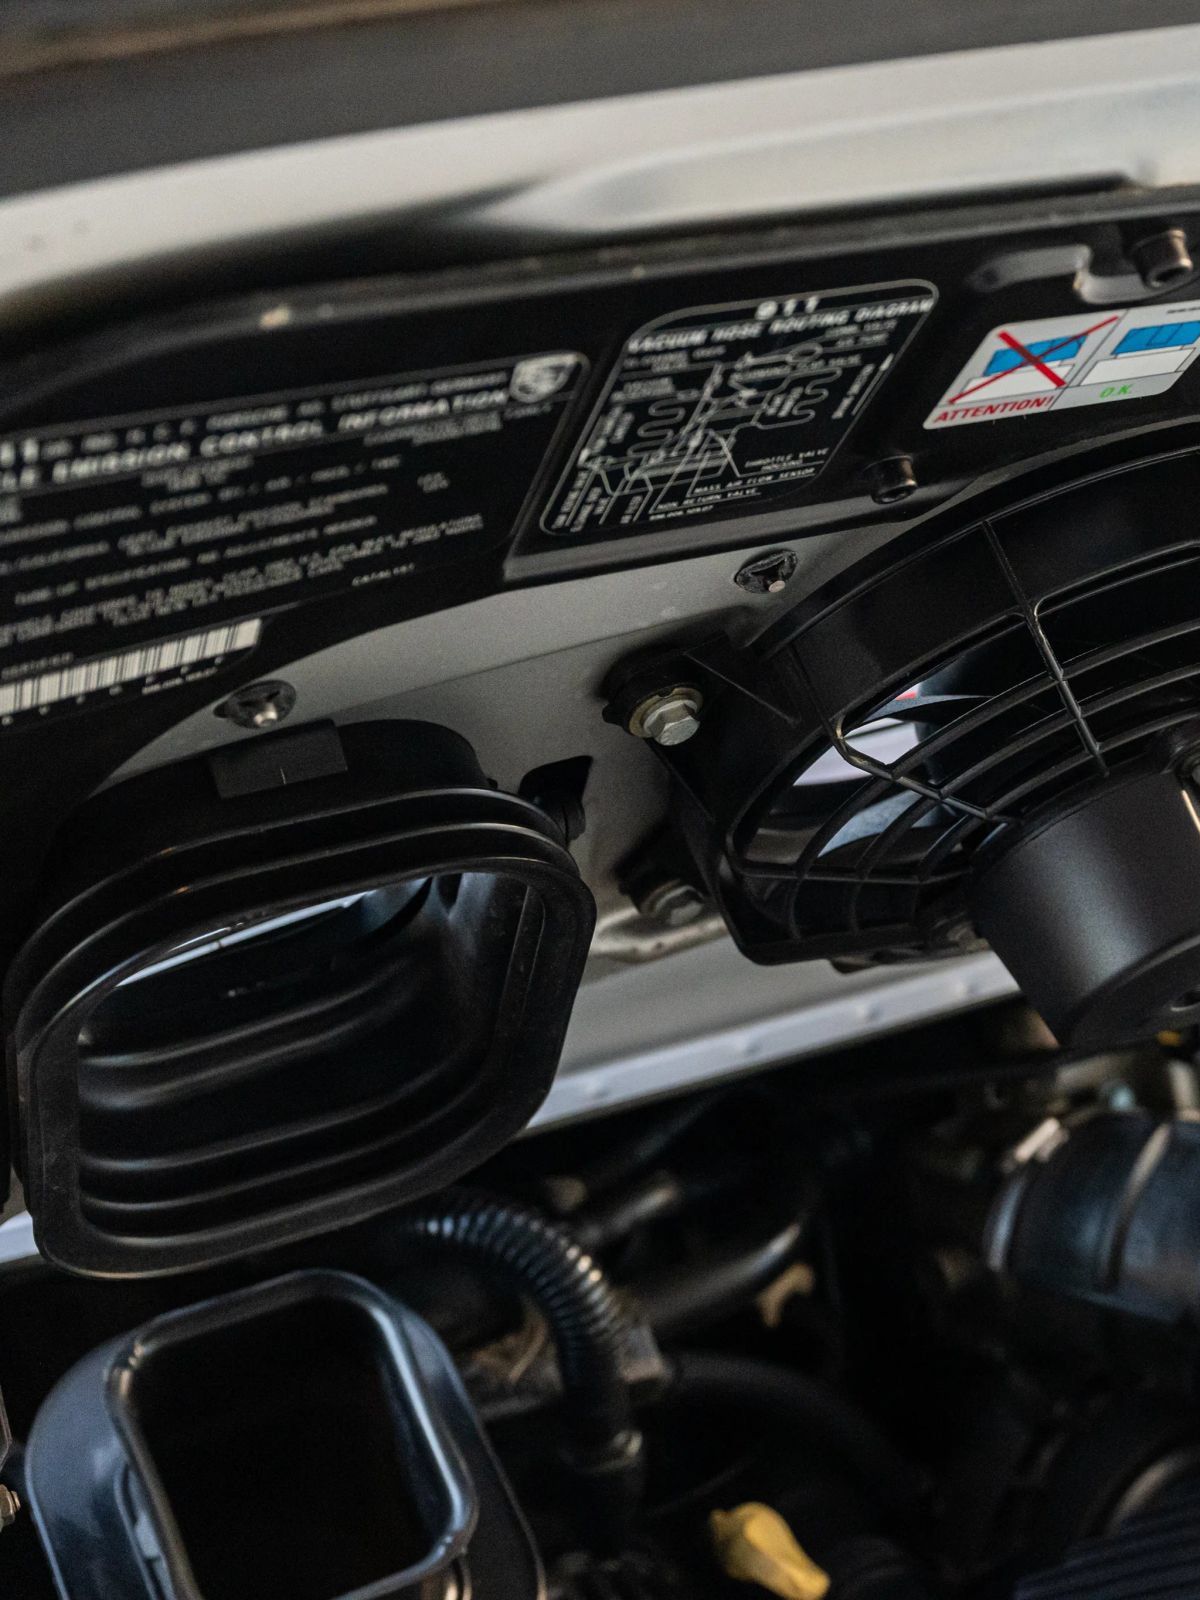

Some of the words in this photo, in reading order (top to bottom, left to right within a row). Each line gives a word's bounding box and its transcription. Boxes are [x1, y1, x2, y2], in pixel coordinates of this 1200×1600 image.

[628, 329, 708, 353] VACUUM
[711, 321, 764, 341] HOSE
[768, 310, 850, 334] ROUTING
[854, 299, 934, 322] DIAGRAM
[755, 295, 819, 321] 911
[933, 395, 1054, 424] ATTENTION!
[53, 442, 190, 484] EMISSION
[200, 420, 322, 457] CONTROL
[338, 388, 507, 431] INFORMATION
